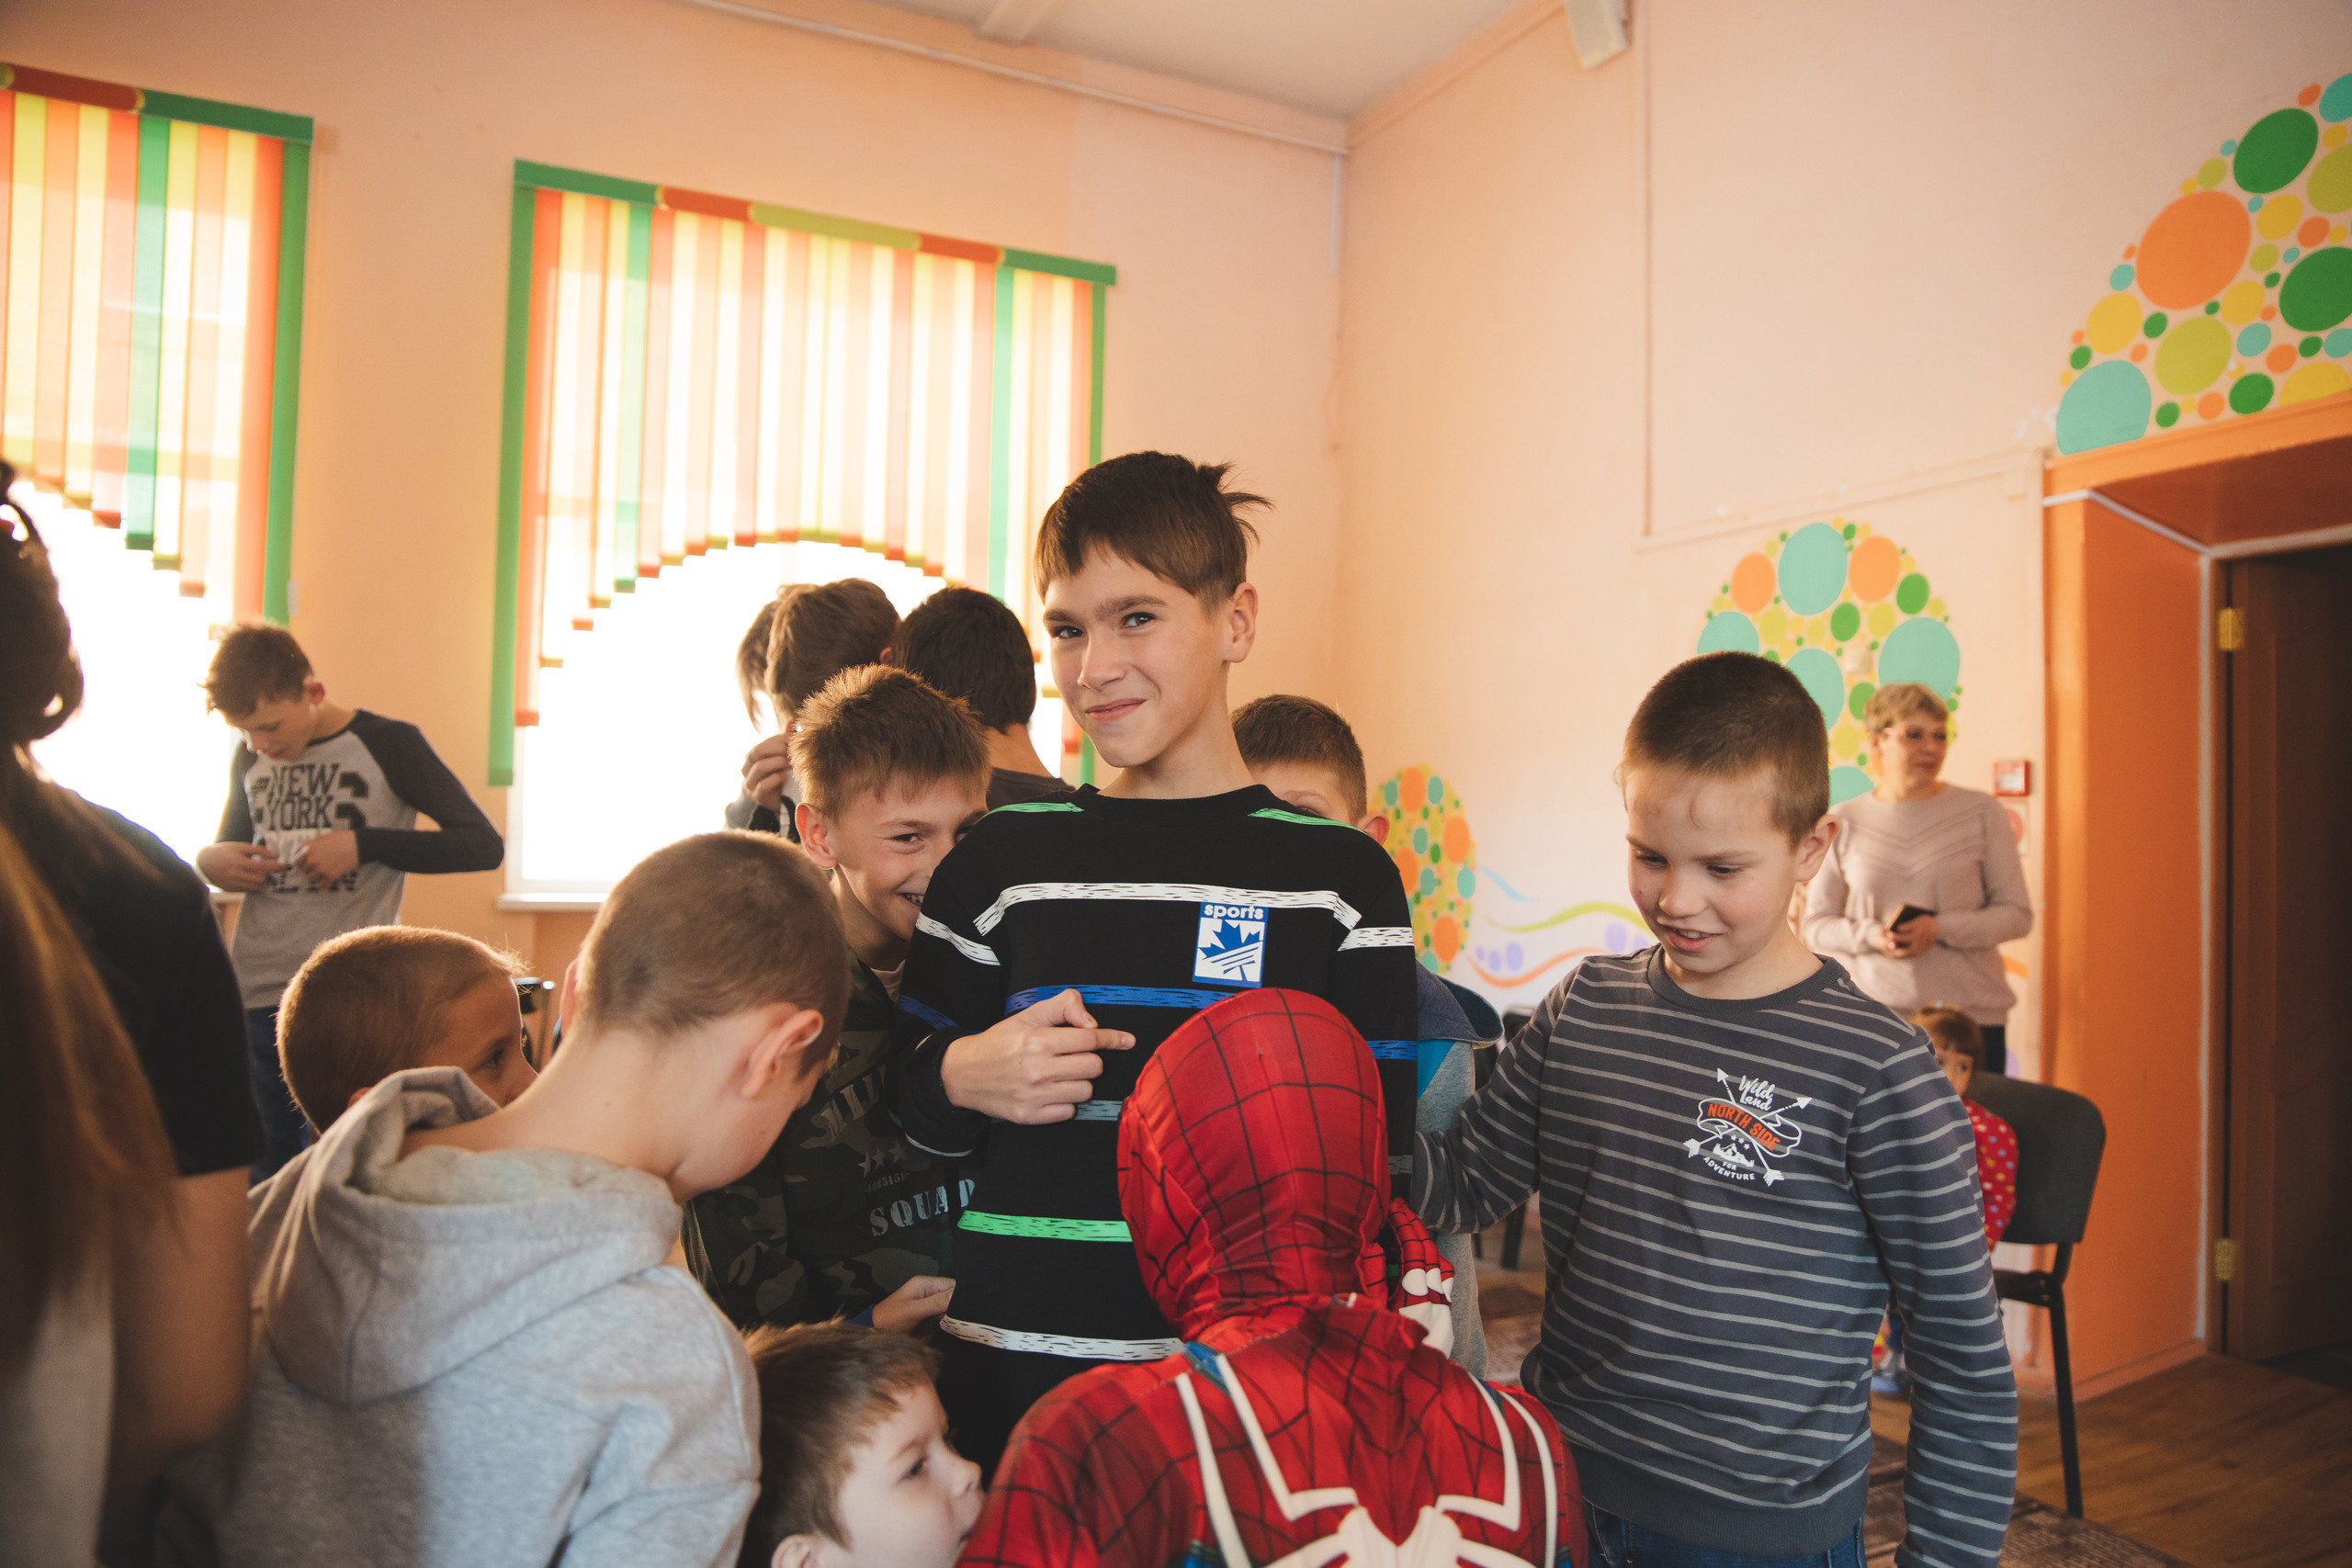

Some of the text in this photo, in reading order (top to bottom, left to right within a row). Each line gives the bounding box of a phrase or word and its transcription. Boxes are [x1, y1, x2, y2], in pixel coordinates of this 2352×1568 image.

[270, 763, 339, 796] NEW
[266, 795, 334, 830] YORK
[1204, 904, 1264, 919] sports
[1738, 1075, 1775, 1100] Wild
[1740, 1089, 1773, 1111] Land
[1707, 1103, 1781, 1151] NORTH SIDE
[1702, 1156, 1755, 1180] ADVENTURE
[1722, 1161, 1737, 1171] FOR
[869, 1179, 976, 1236] SQUAD
